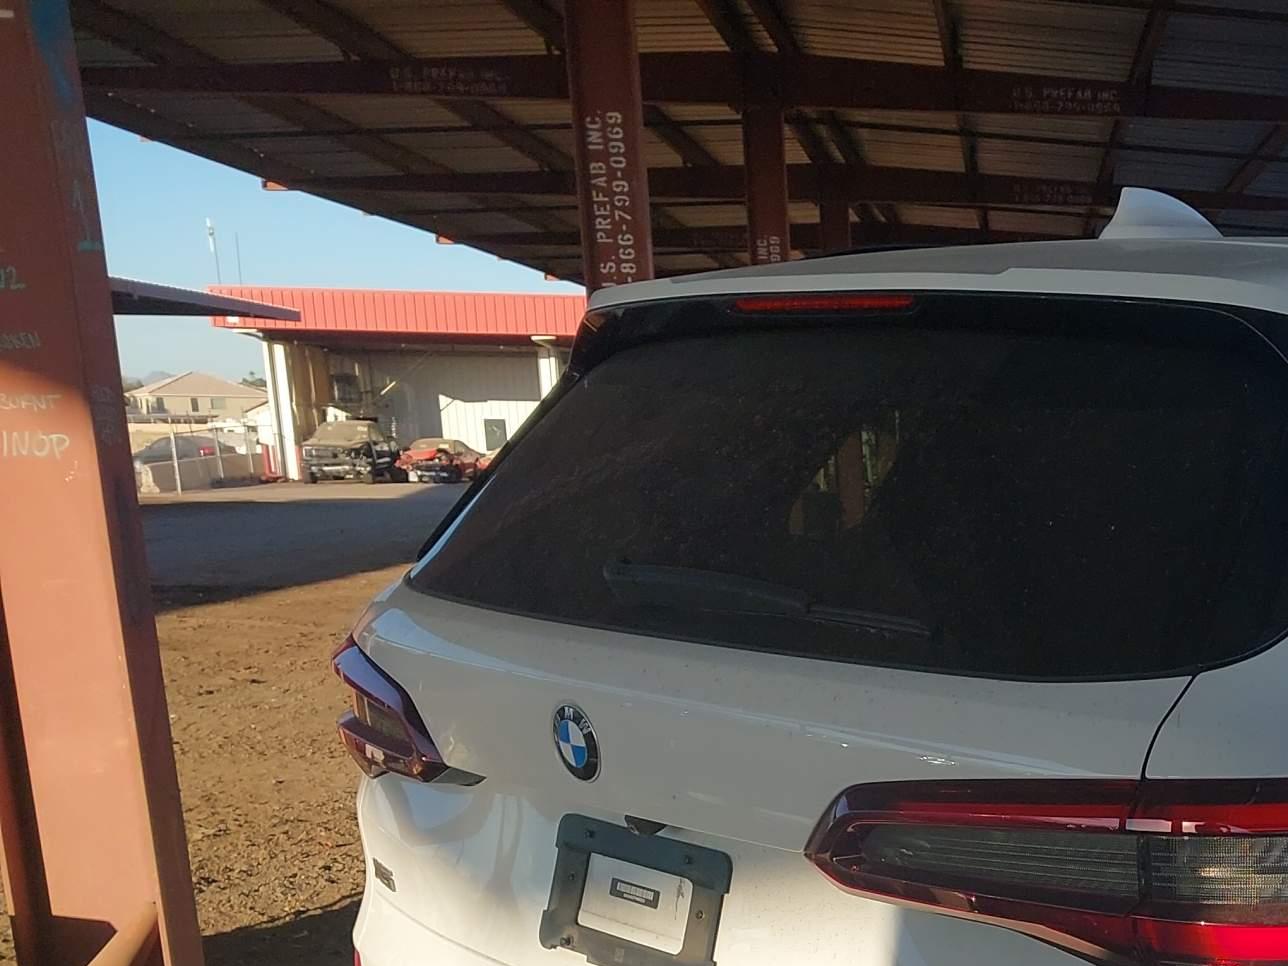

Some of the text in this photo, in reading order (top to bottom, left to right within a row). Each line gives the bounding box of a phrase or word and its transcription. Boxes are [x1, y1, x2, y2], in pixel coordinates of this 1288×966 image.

[585, 110, 604, 150] INC.
[590, 162, 614, 243] PREFAB
[2, 427, 71, 460] INOP
